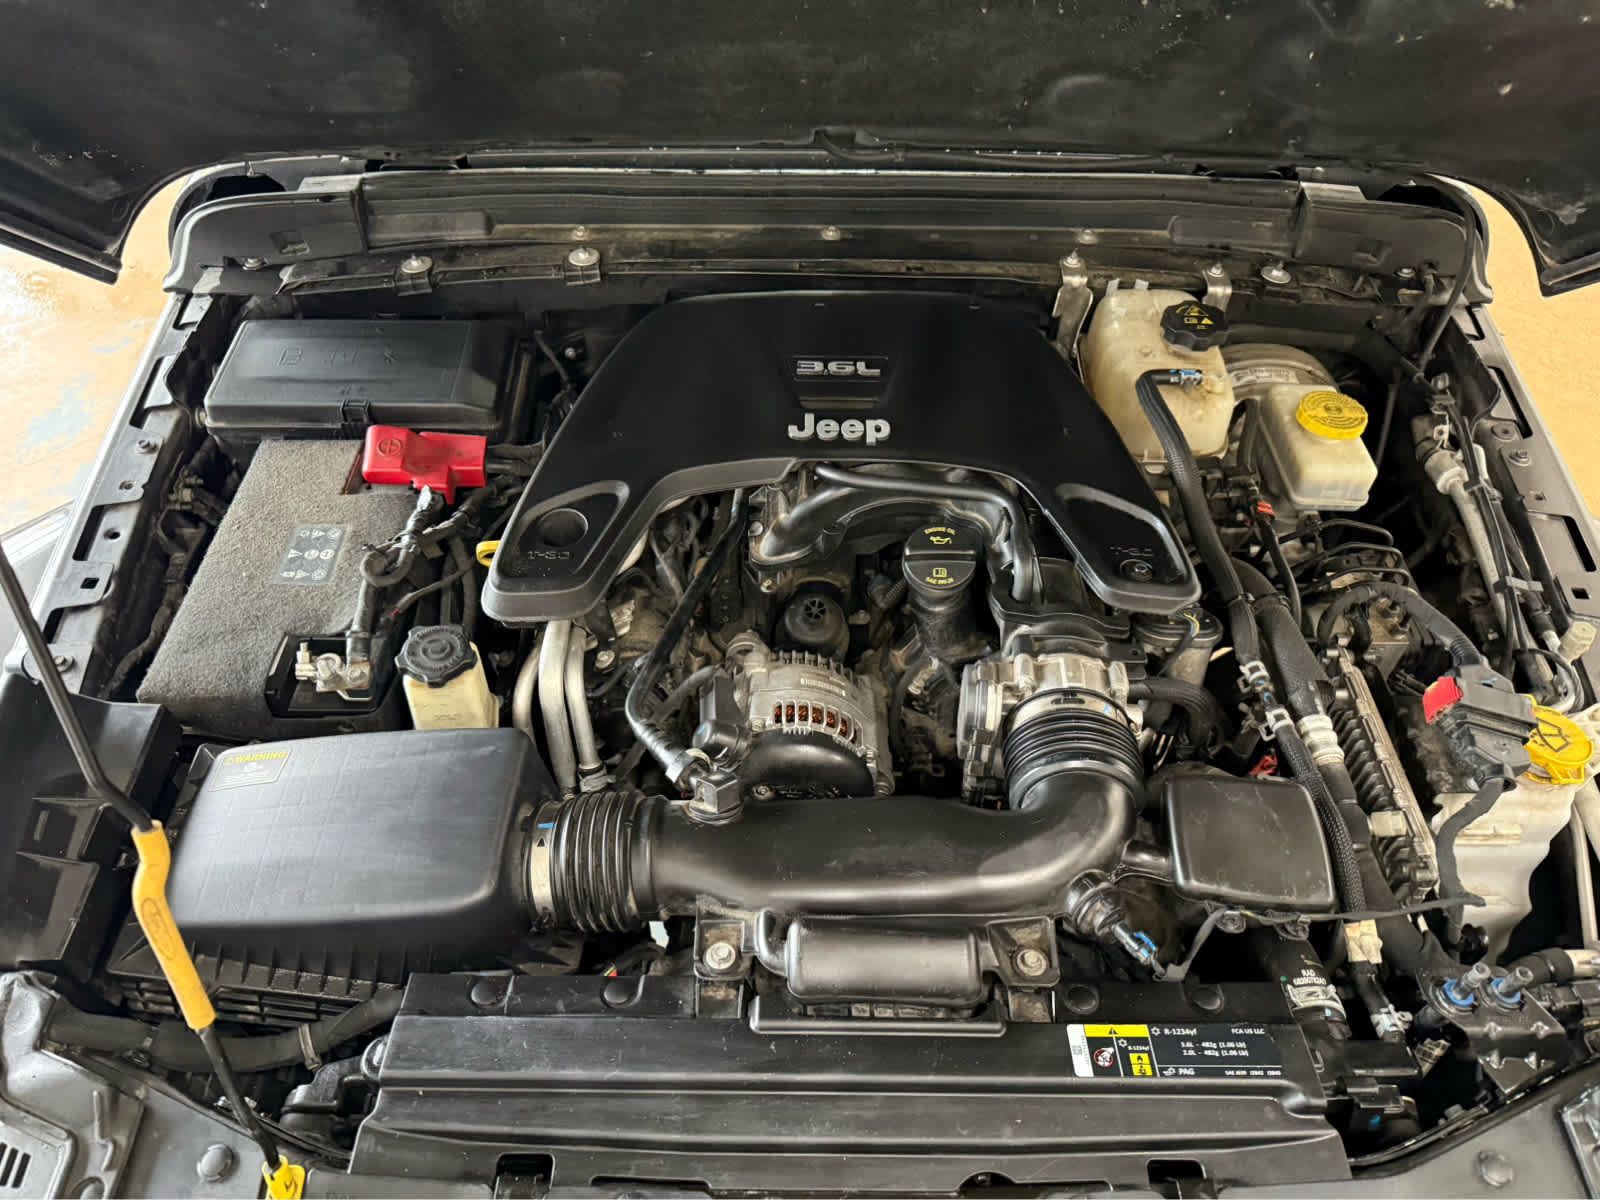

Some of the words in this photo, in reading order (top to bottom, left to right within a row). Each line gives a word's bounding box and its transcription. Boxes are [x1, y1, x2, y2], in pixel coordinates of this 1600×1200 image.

[796, 360, 881, 376] 3.6L
[787, 412, 891, 446] Jeep
[236, 752, 287, 763] WARNING
